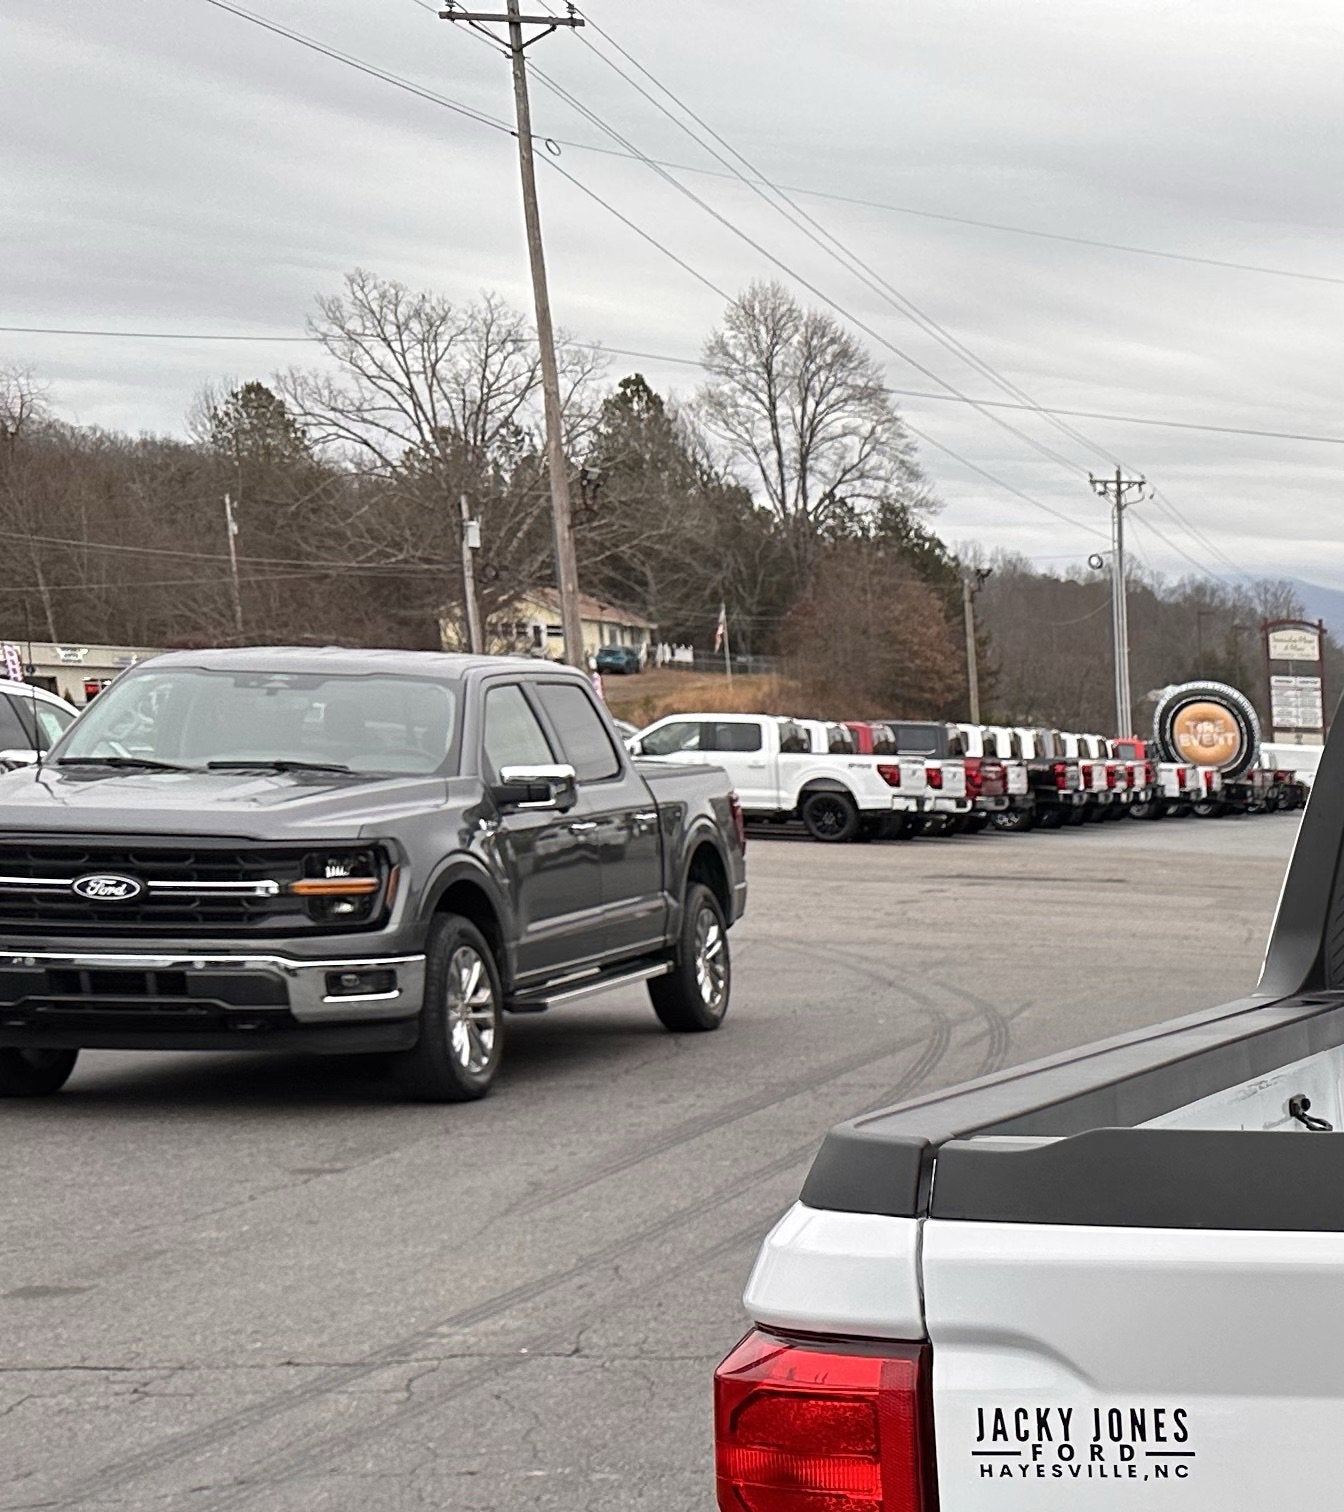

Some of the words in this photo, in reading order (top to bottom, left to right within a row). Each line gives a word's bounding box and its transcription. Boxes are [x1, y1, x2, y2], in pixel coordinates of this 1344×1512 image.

[1185, 719, 1226, 734] TIRE
[1178, 732, 1236, 747] EVENT
[85, 878, 128, 896] Ford
[976, 1407, 1073, 1442] JACKY
[1092, 1407, 1189, 1442] JONES
[1032, 1443, 1135, 1462] FORD
